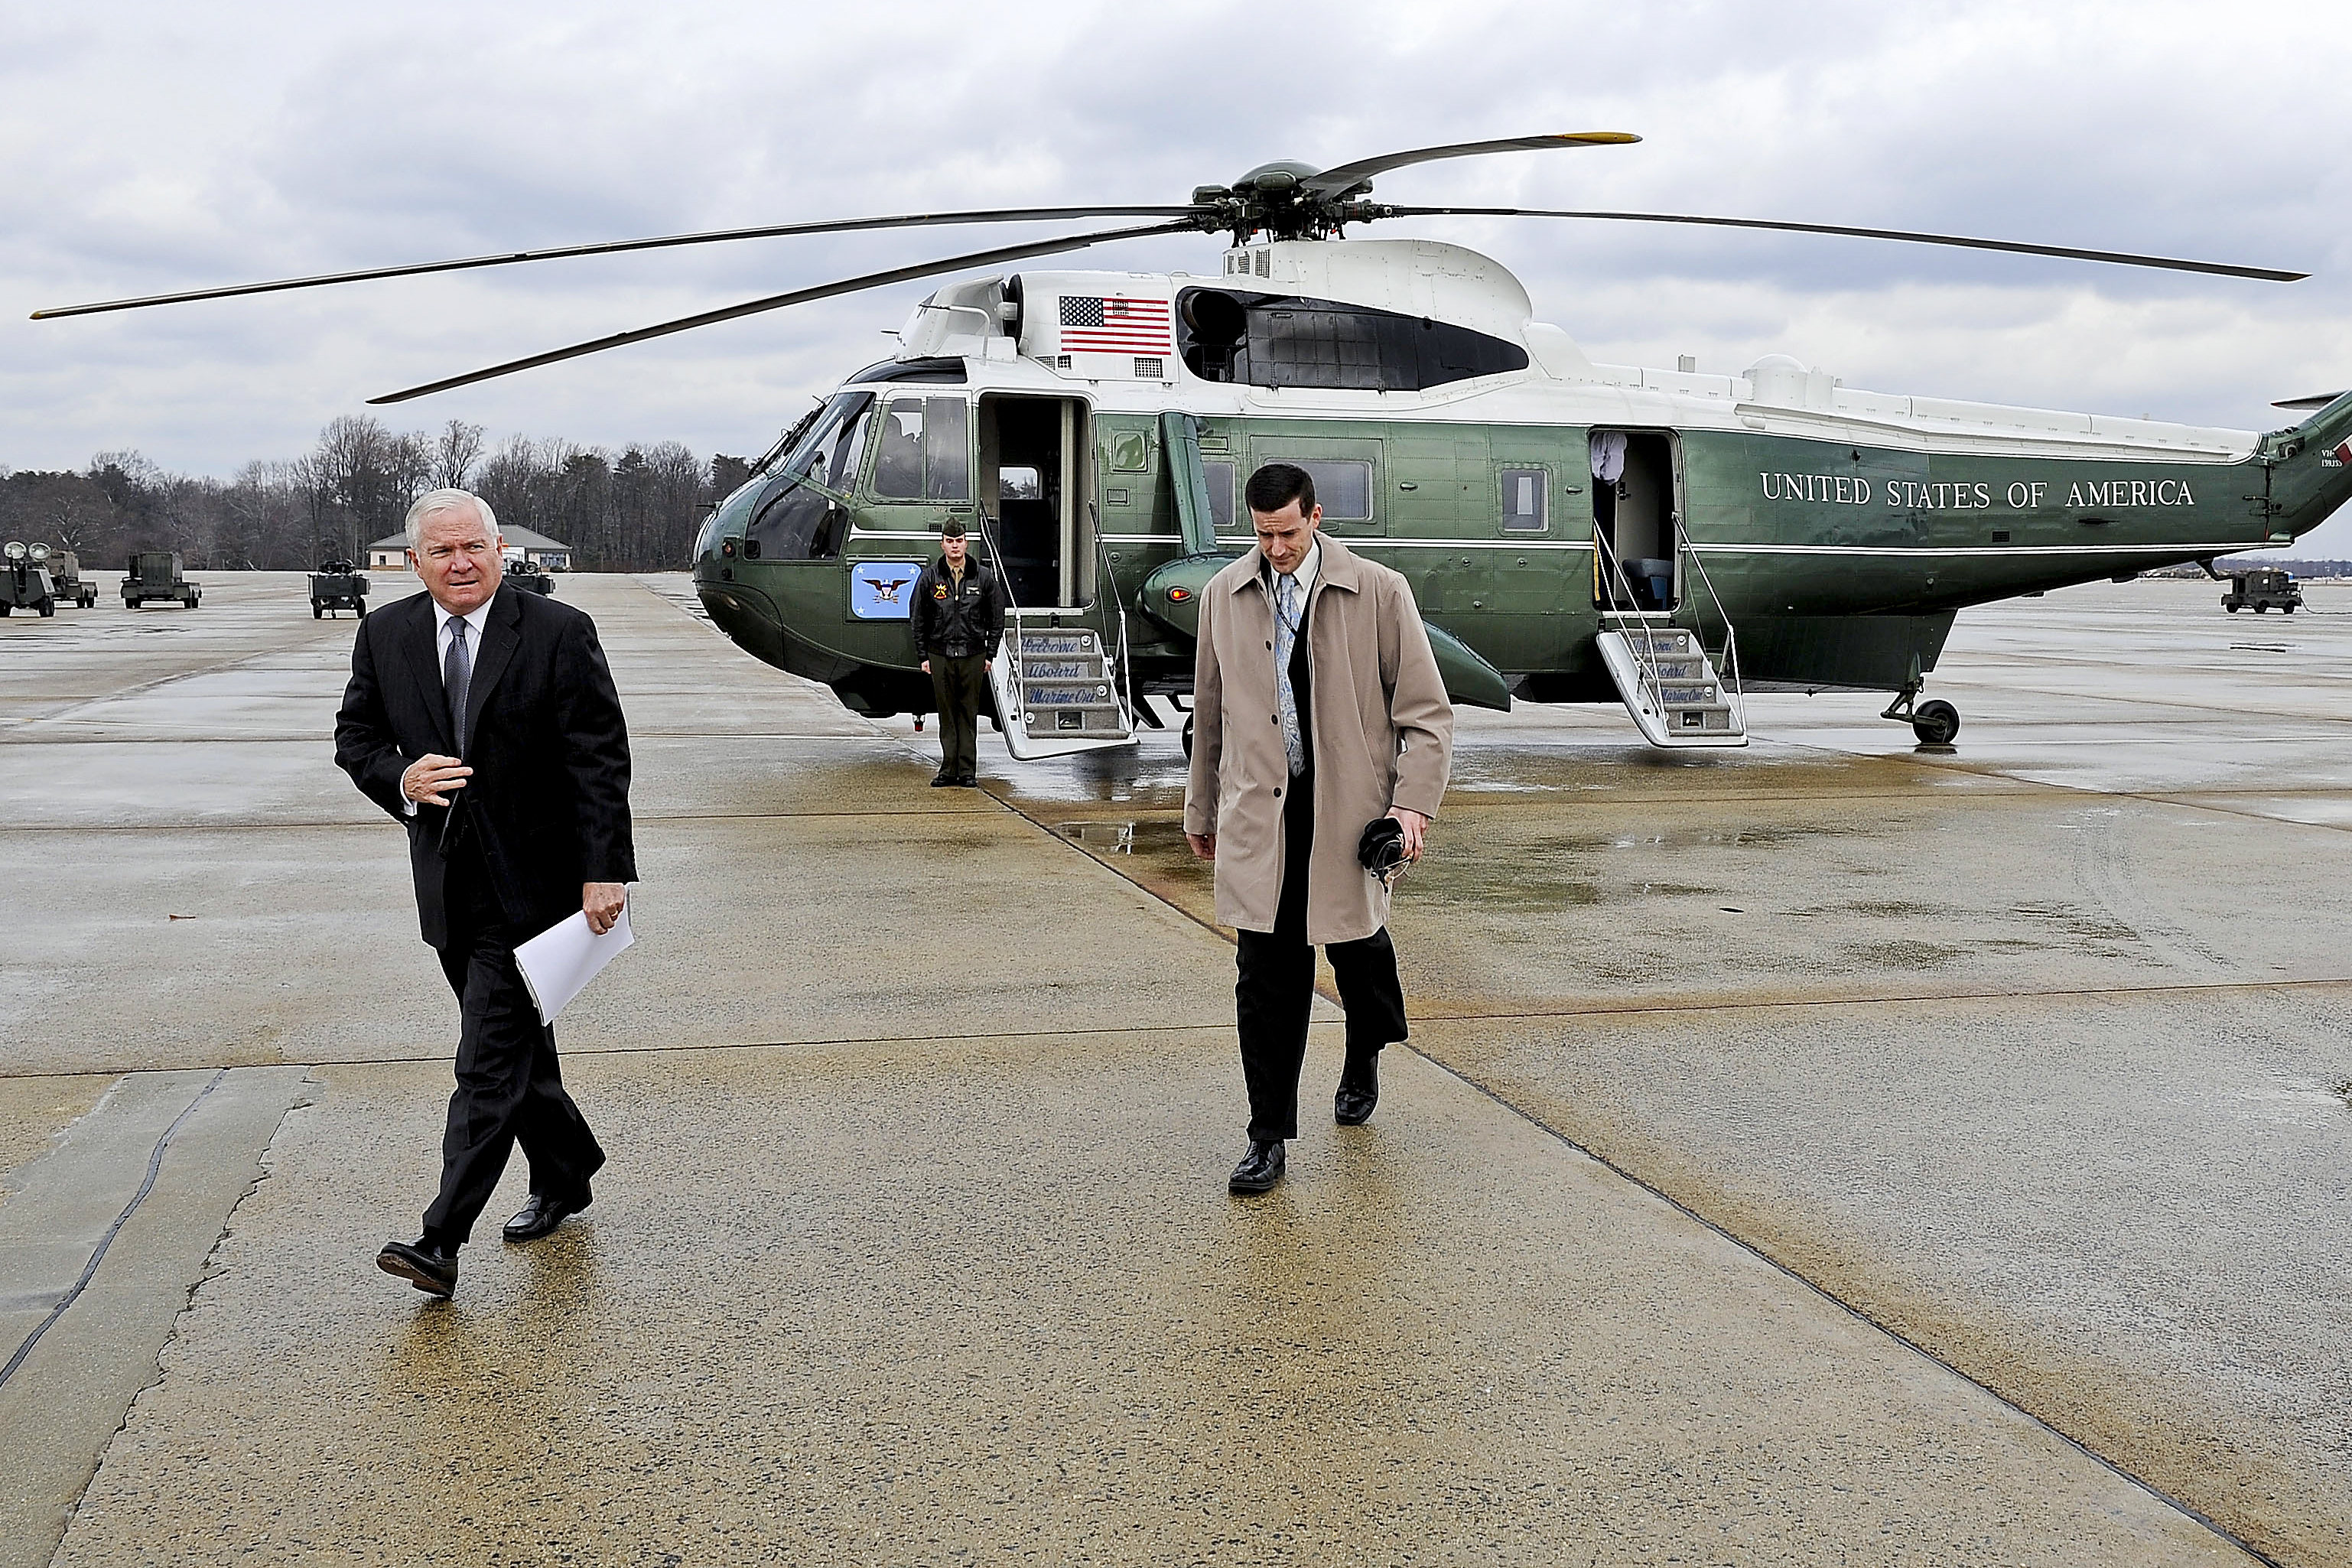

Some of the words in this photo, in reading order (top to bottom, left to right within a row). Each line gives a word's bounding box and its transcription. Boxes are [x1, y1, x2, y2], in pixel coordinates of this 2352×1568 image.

[1759, 471, 1871, 505] UNITED
[1887, 480, 1990, 509] STATES
[2007, 482, 2048, 508] OF
[2064, 480, 2194, 507] AMERICA
[1021, 637, 1078, 653] Welcome
[1029, 662, 1081, 678] Aboard
[1028, 688, 1074, 704] Marine
[1075, 688, 1096, 704] One
